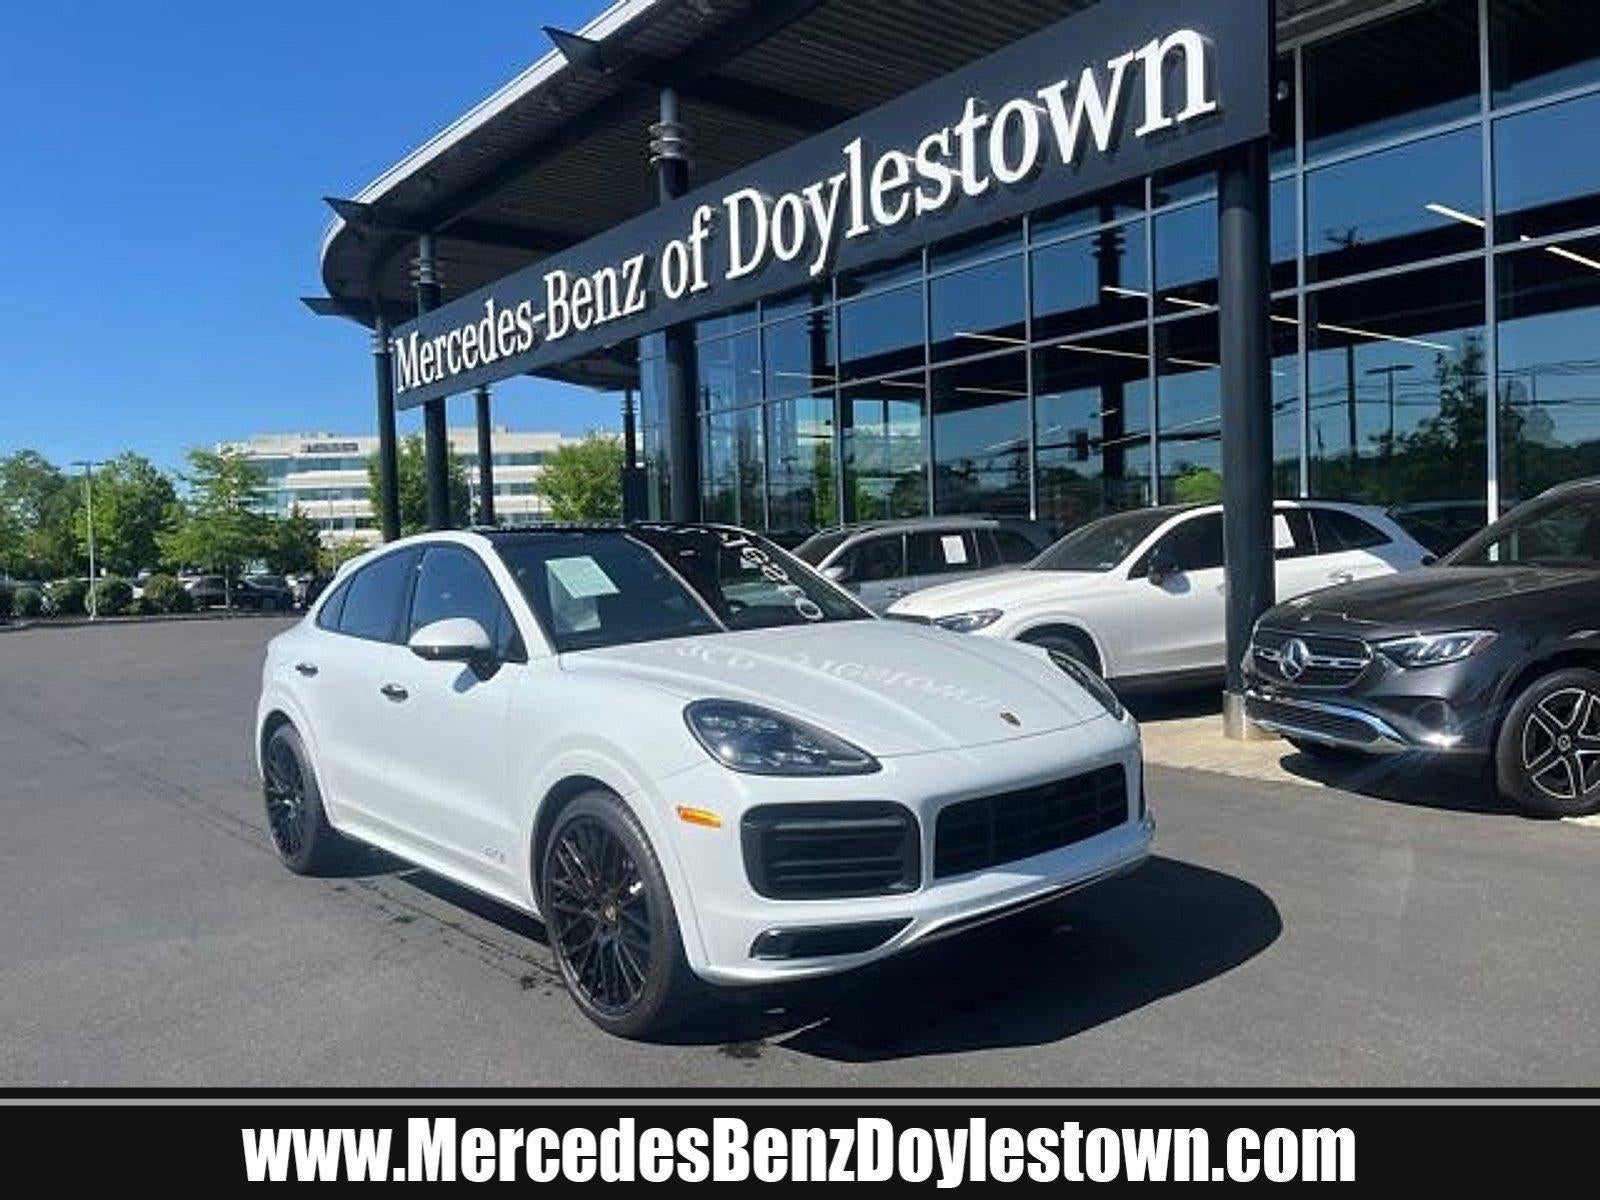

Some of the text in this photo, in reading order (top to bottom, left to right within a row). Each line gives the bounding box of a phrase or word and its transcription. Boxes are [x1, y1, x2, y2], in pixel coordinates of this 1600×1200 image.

[395, 28, 1218, 393] Mercedes-Benz of Doylestown
